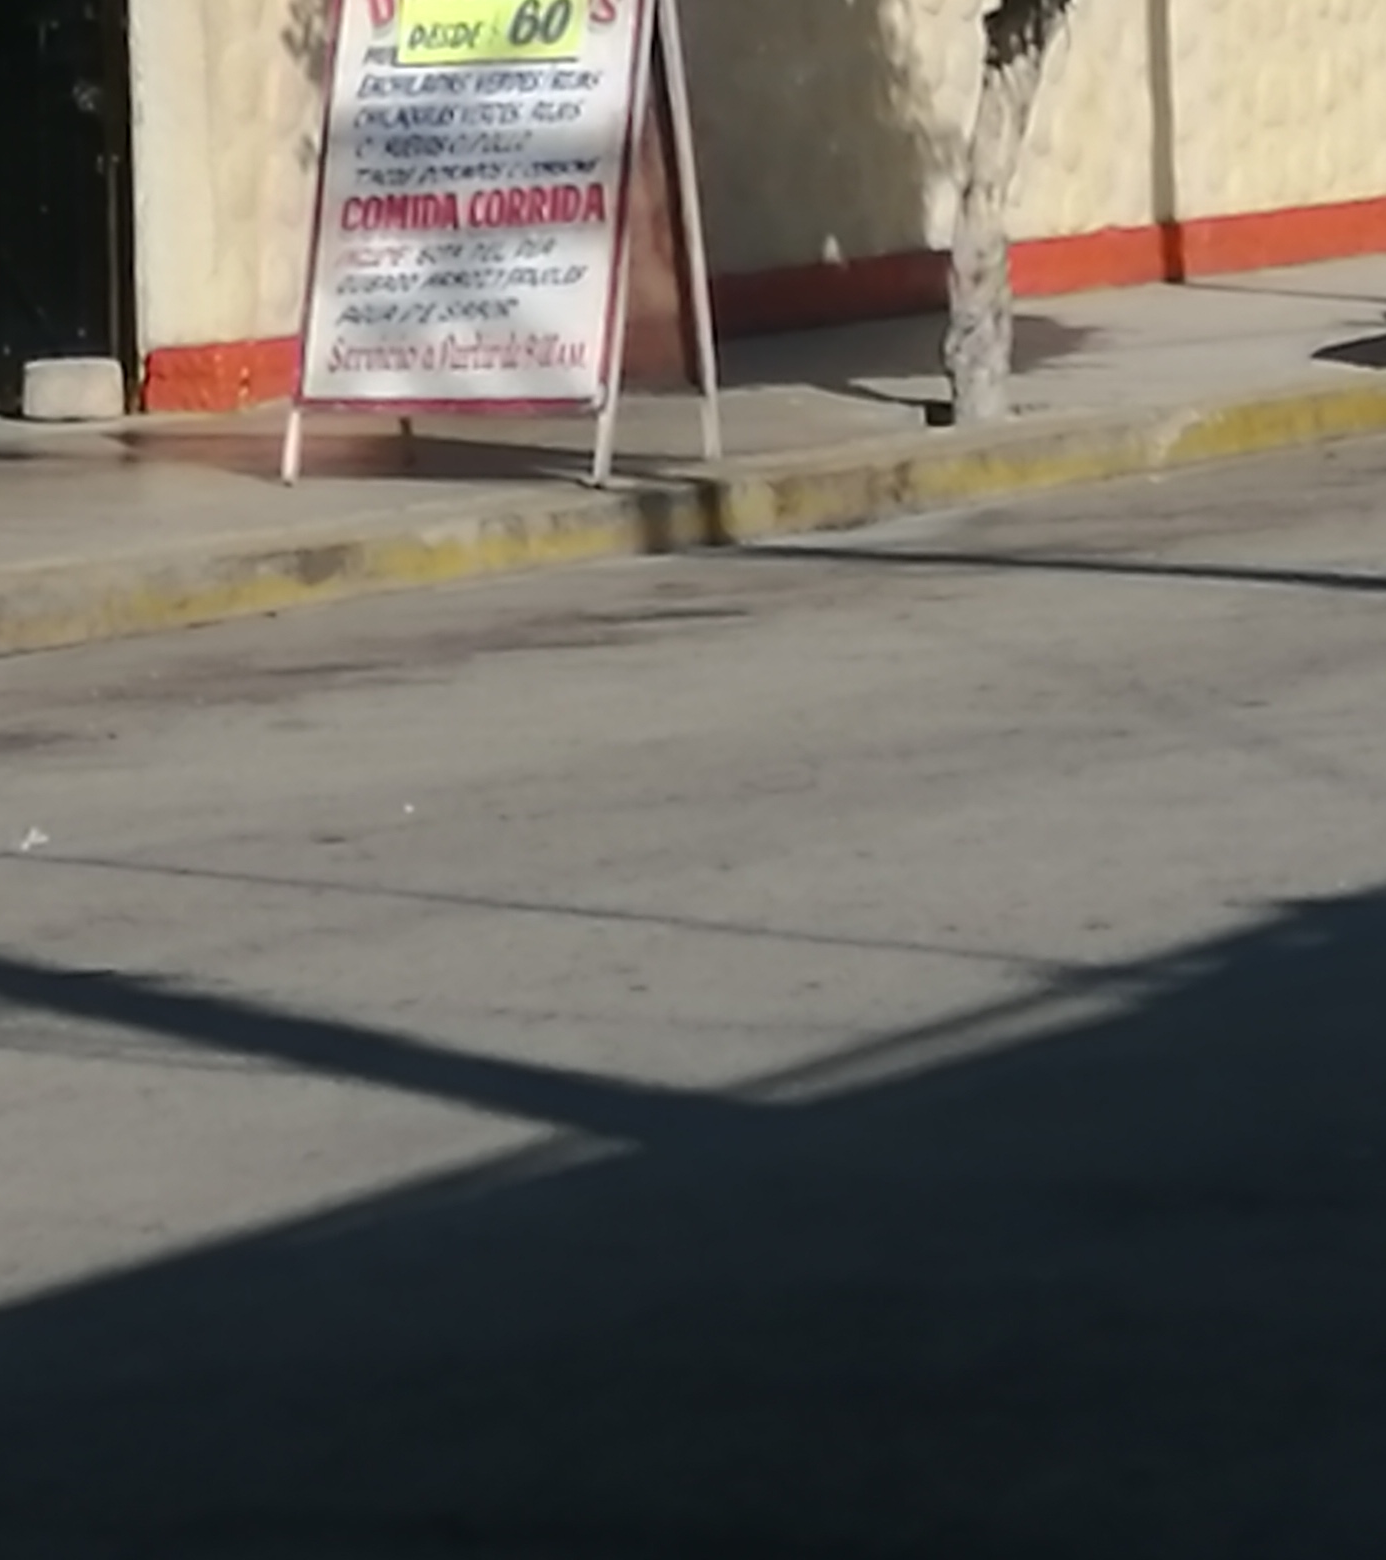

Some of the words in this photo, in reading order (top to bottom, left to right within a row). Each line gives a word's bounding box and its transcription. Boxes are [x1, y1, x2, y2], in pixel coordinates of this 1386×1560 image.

[408, 20, 482, 50] DESDE
[340, 192, 460, 232] COMIDA
[467, 182, 607, 228] CORRIDA
